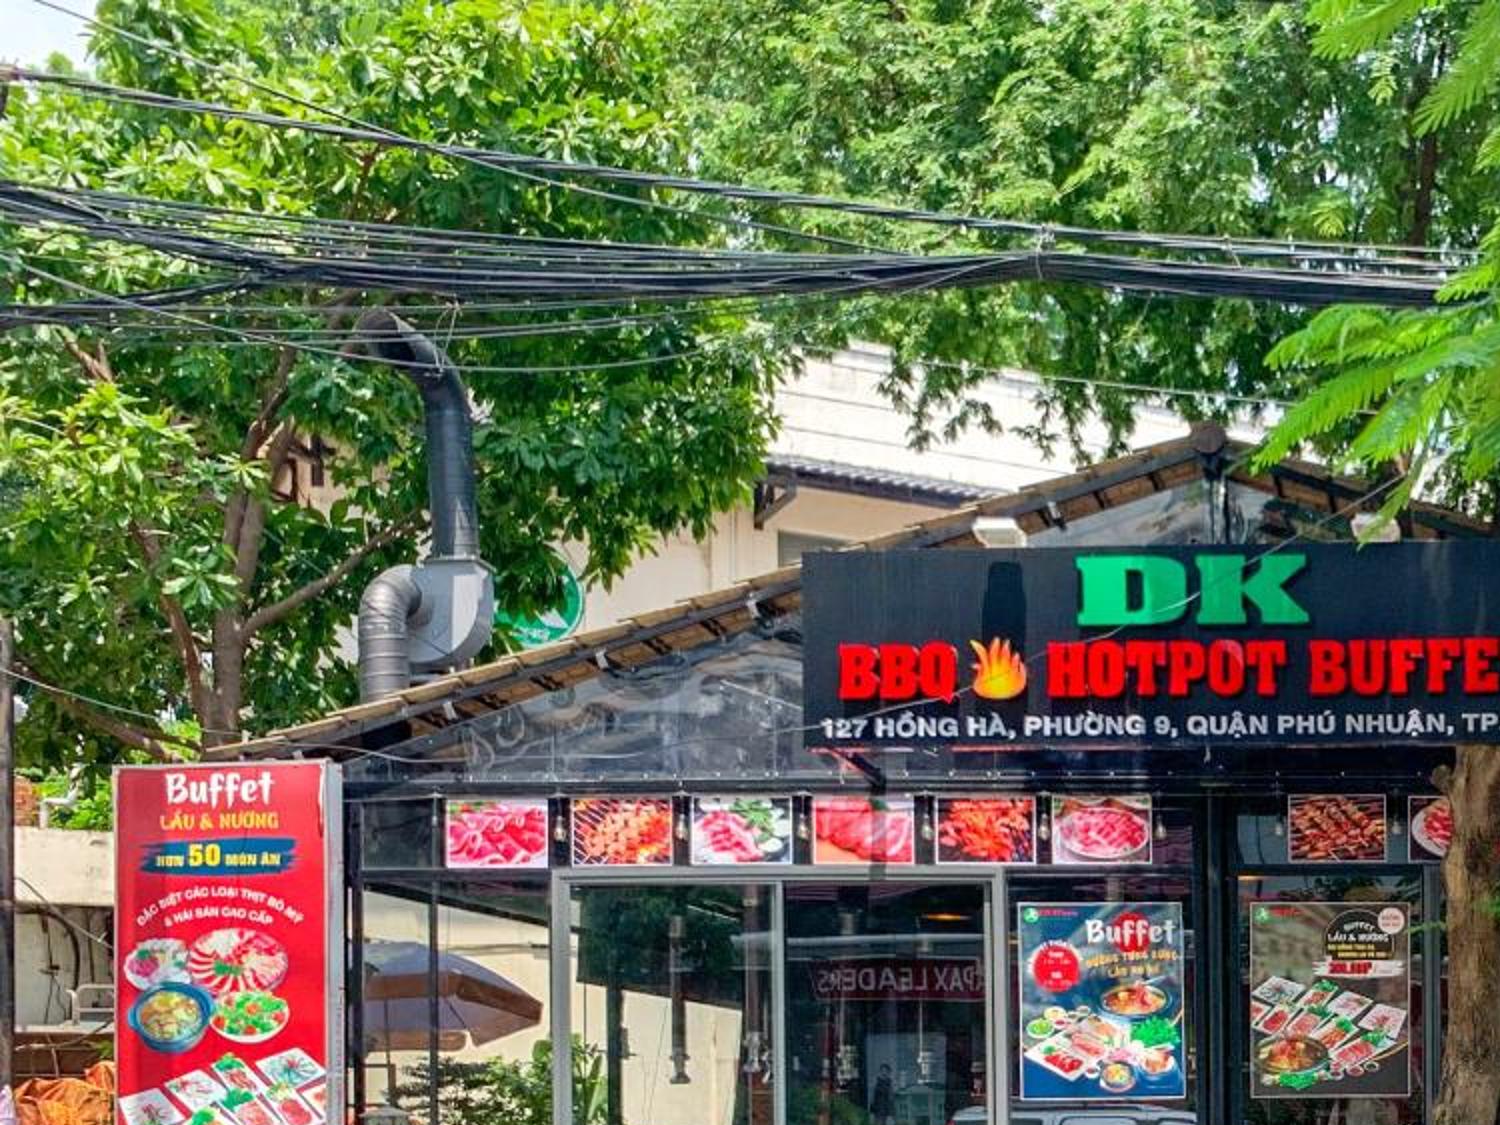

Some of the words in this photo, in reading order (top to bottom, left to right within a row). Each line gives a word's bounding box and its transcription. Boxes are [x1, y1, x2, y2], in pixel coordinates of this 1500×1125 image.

[1075, 554, 1310, 626] DK
[838, 643, 958, 703] BBQ
[1046, 638, 1286, 699] HOTPOT
[821, 716, 867, 739] 127
[875, 711, 960, 738] HỒNG
[966, 713, 1017, 740] HÀ,
[1023, 712, 1147, 737] PHƯỜNG
[1153, 716, 1179, 738] 9,
[1186, 710, 1270, 739] QUẬN
[1277, 709, 1337, 735] PHÚ
[1345, 708, 1455, 737] NHUẬN,
[165, 771, 275, 809] Buffet
[199, 815, 214, 829] &
[188, 843, 221, 867] 50
[184, 886, 209, 900] CÁC
[221, 905, 247, 919] CAO
[1085, 919, 1177, 947] Buffet
